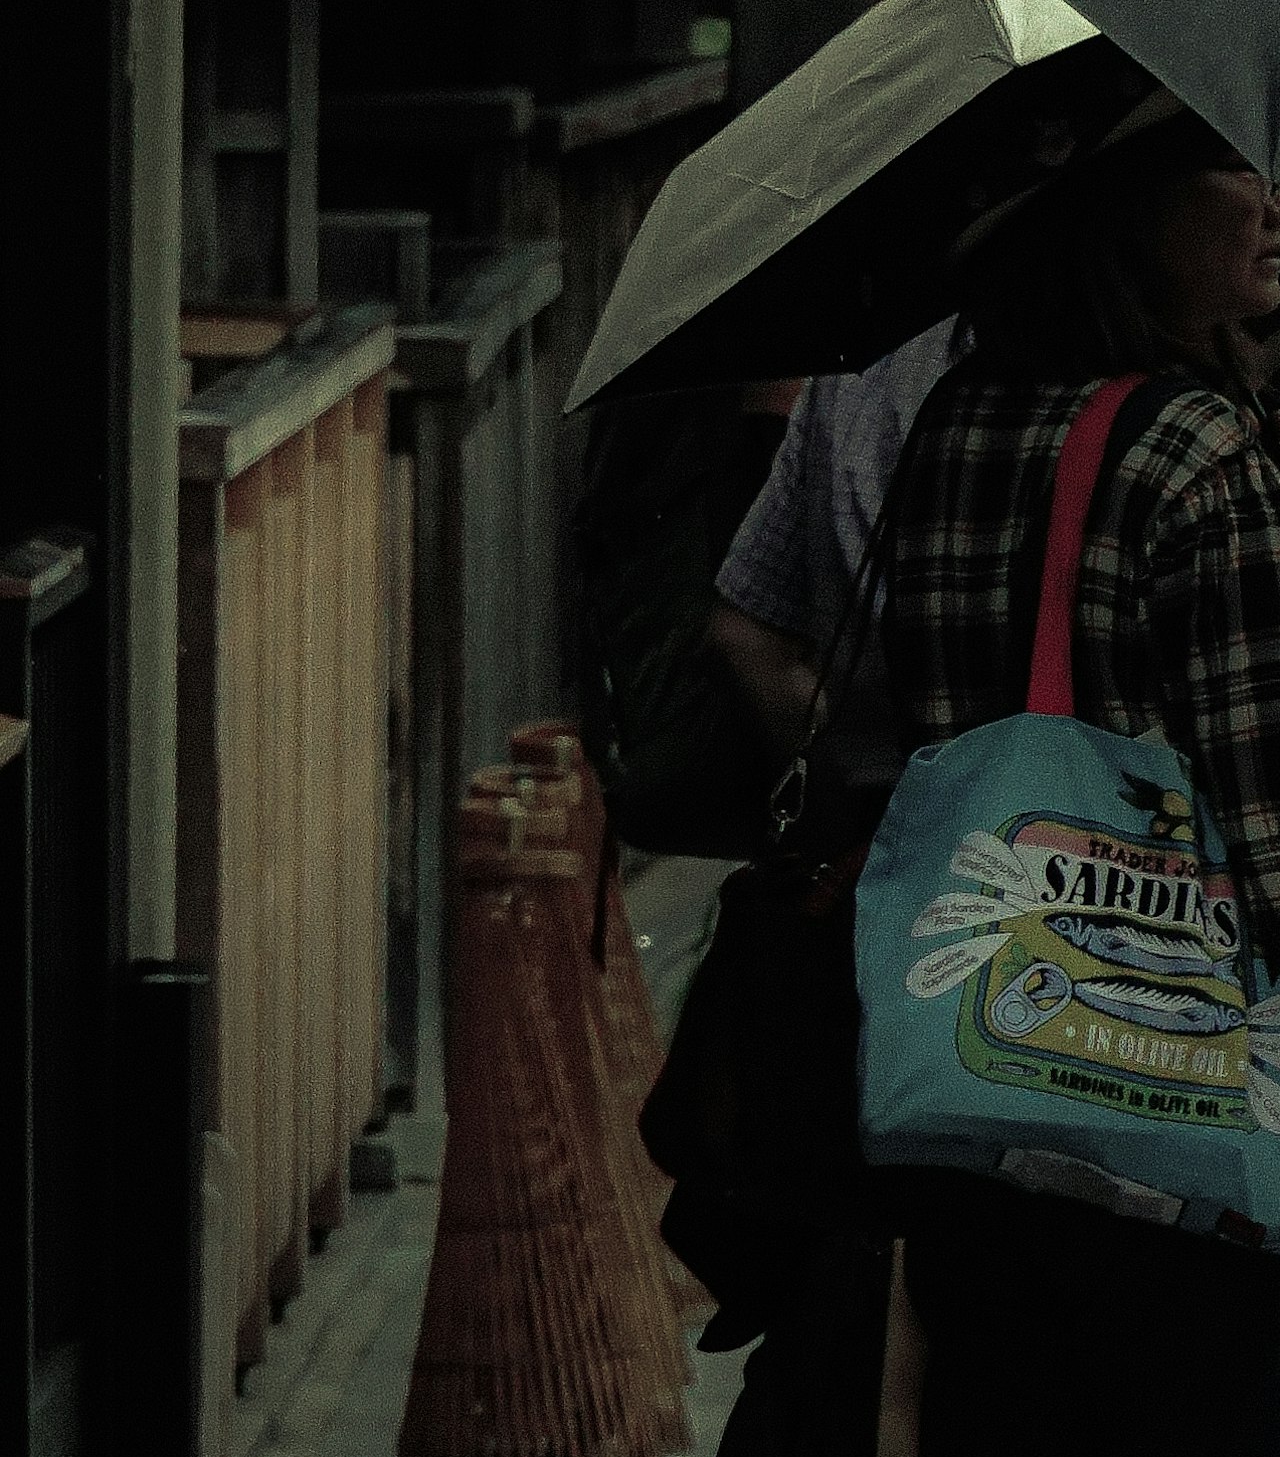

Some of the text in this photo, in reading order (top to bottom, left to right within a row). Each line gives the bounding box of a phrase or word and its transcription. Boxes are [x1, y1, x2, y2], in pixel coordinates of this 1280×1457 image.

[1089, 840, 1166, 872] TRADER
[1041, 854, 1236, 946] SARDINS
[1086, 1024, 1228, 1077] IN OLIVE OIL
[1049, 1068, 1124, 1101] SARDINES
[1148, 1093, 1190, 1114] OLIVE
[1196, 1100, 1220, 1117] OIL
